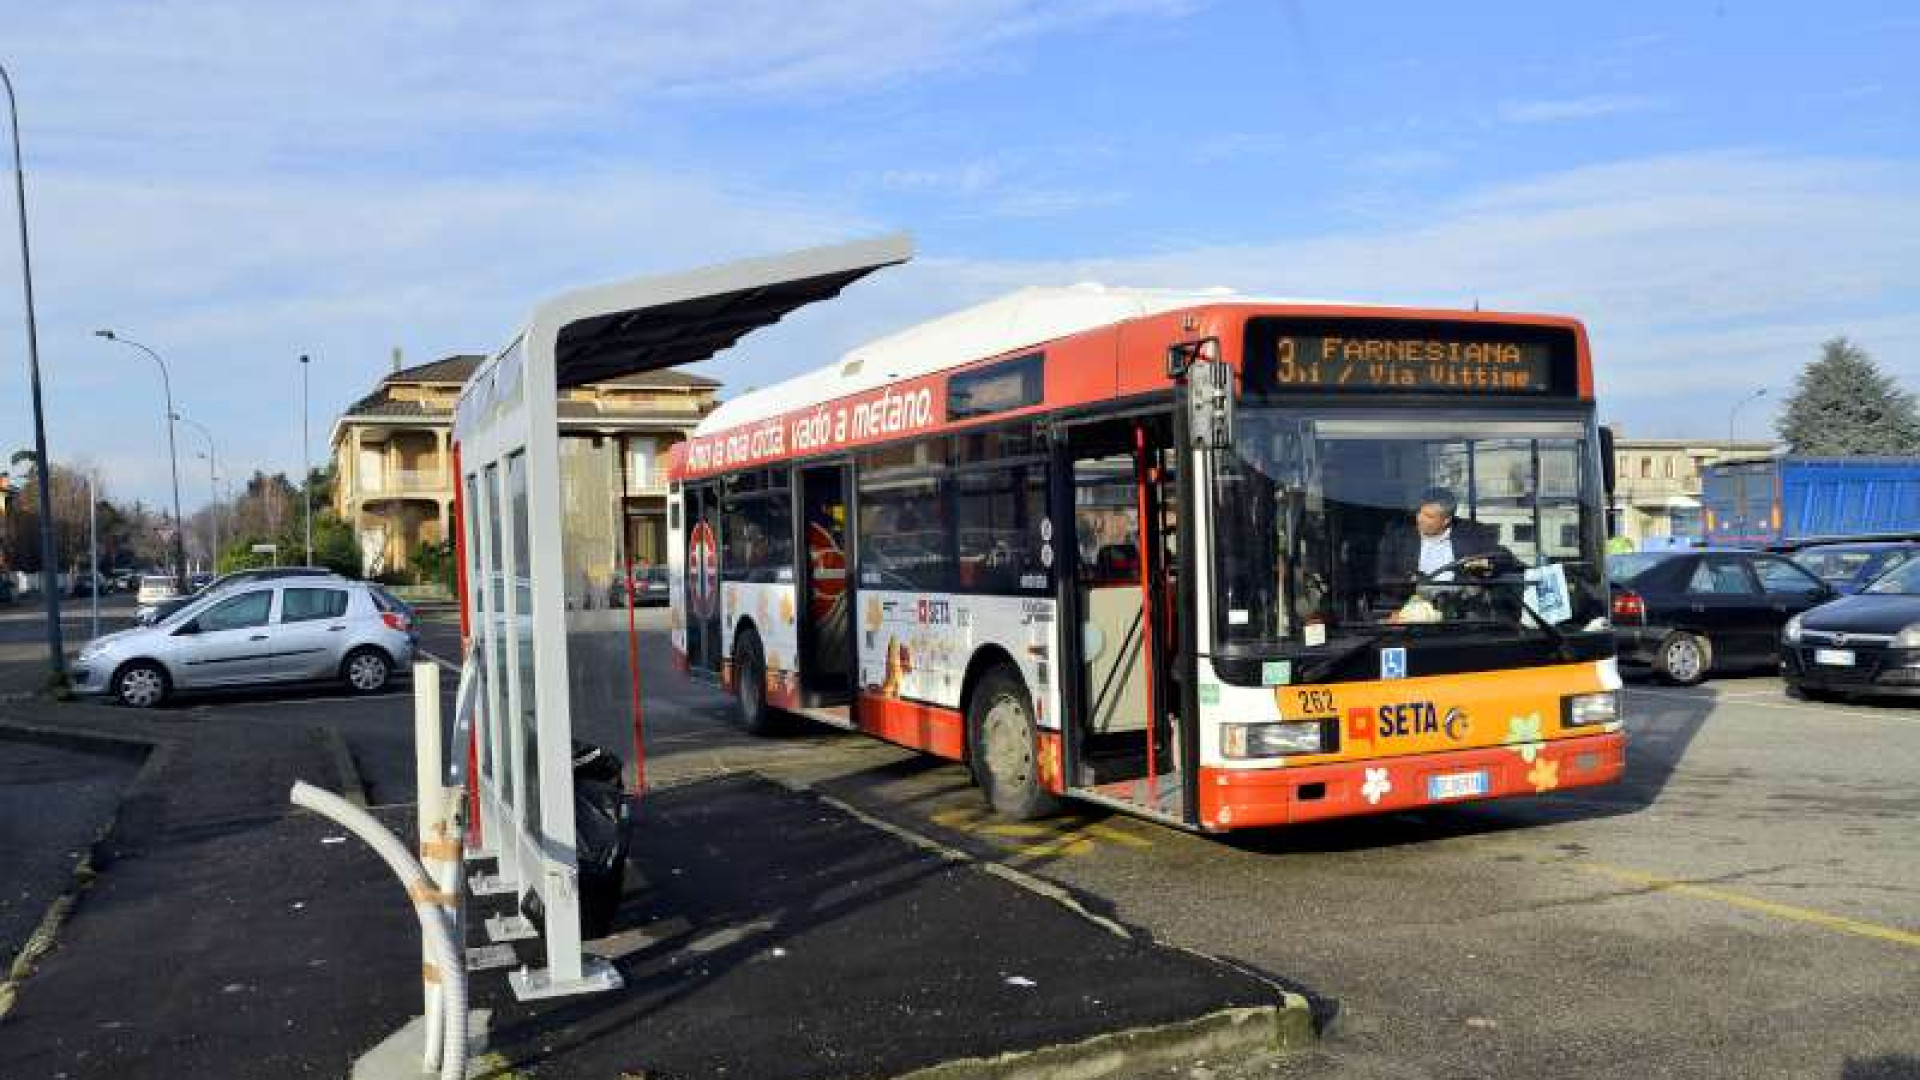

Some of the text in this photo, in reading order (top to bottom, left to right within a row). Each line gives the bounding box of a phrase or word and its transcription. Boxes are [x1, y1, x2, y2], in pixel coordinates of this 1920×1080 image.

[1277, 337, 1295, 383] 3
[1323, 337, 1521, 363] FARNESIANA
[791, 405, 831, 451] vado
[834, 407, 847, 443] a
[1298, 689, 1337, 714] 262
[1379, 701, 1439, 738] SETA
